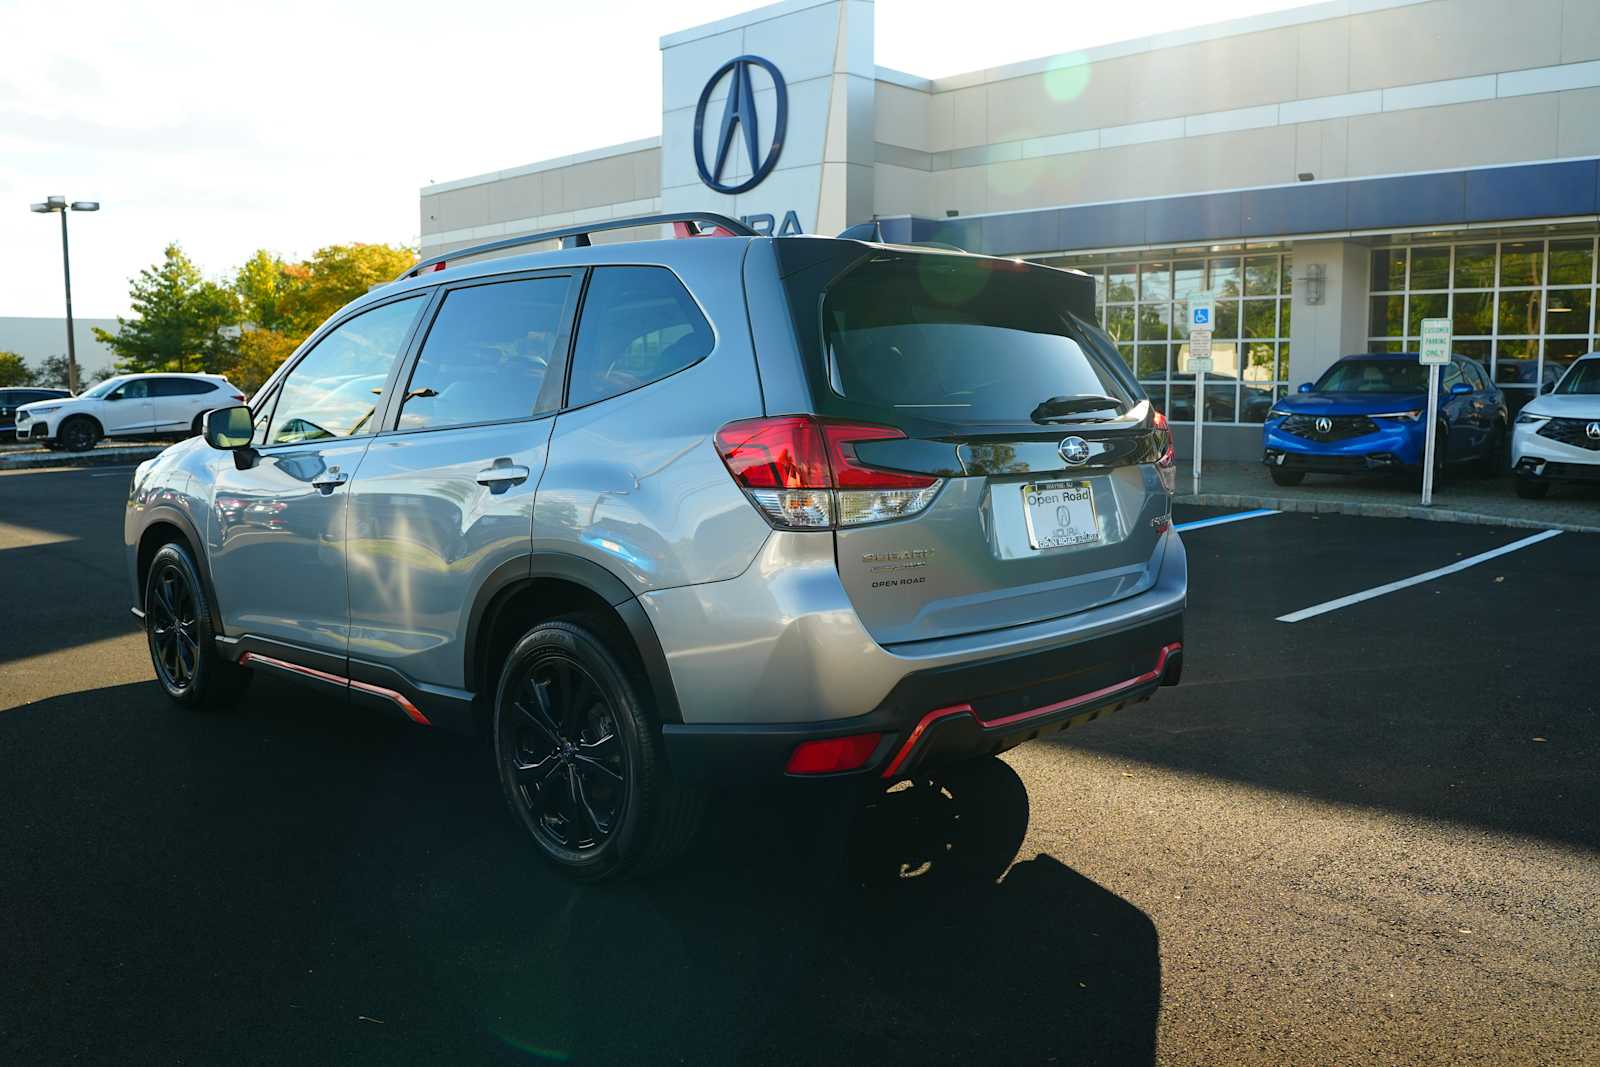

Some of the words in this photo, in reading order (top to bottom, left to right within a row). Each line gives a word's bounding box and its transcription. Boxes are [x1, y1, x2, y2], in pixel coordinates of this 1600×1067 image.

[1425, 336, 1447, 345] PARKING
[1425, 349, 1444, 359] ONLY
[1028, 495, 1059, 507] Open
[1063, 491, 1089, 502] Road
[872, 580, 898, 588] OPEN
[900, 577, 926, 585] ROAD
